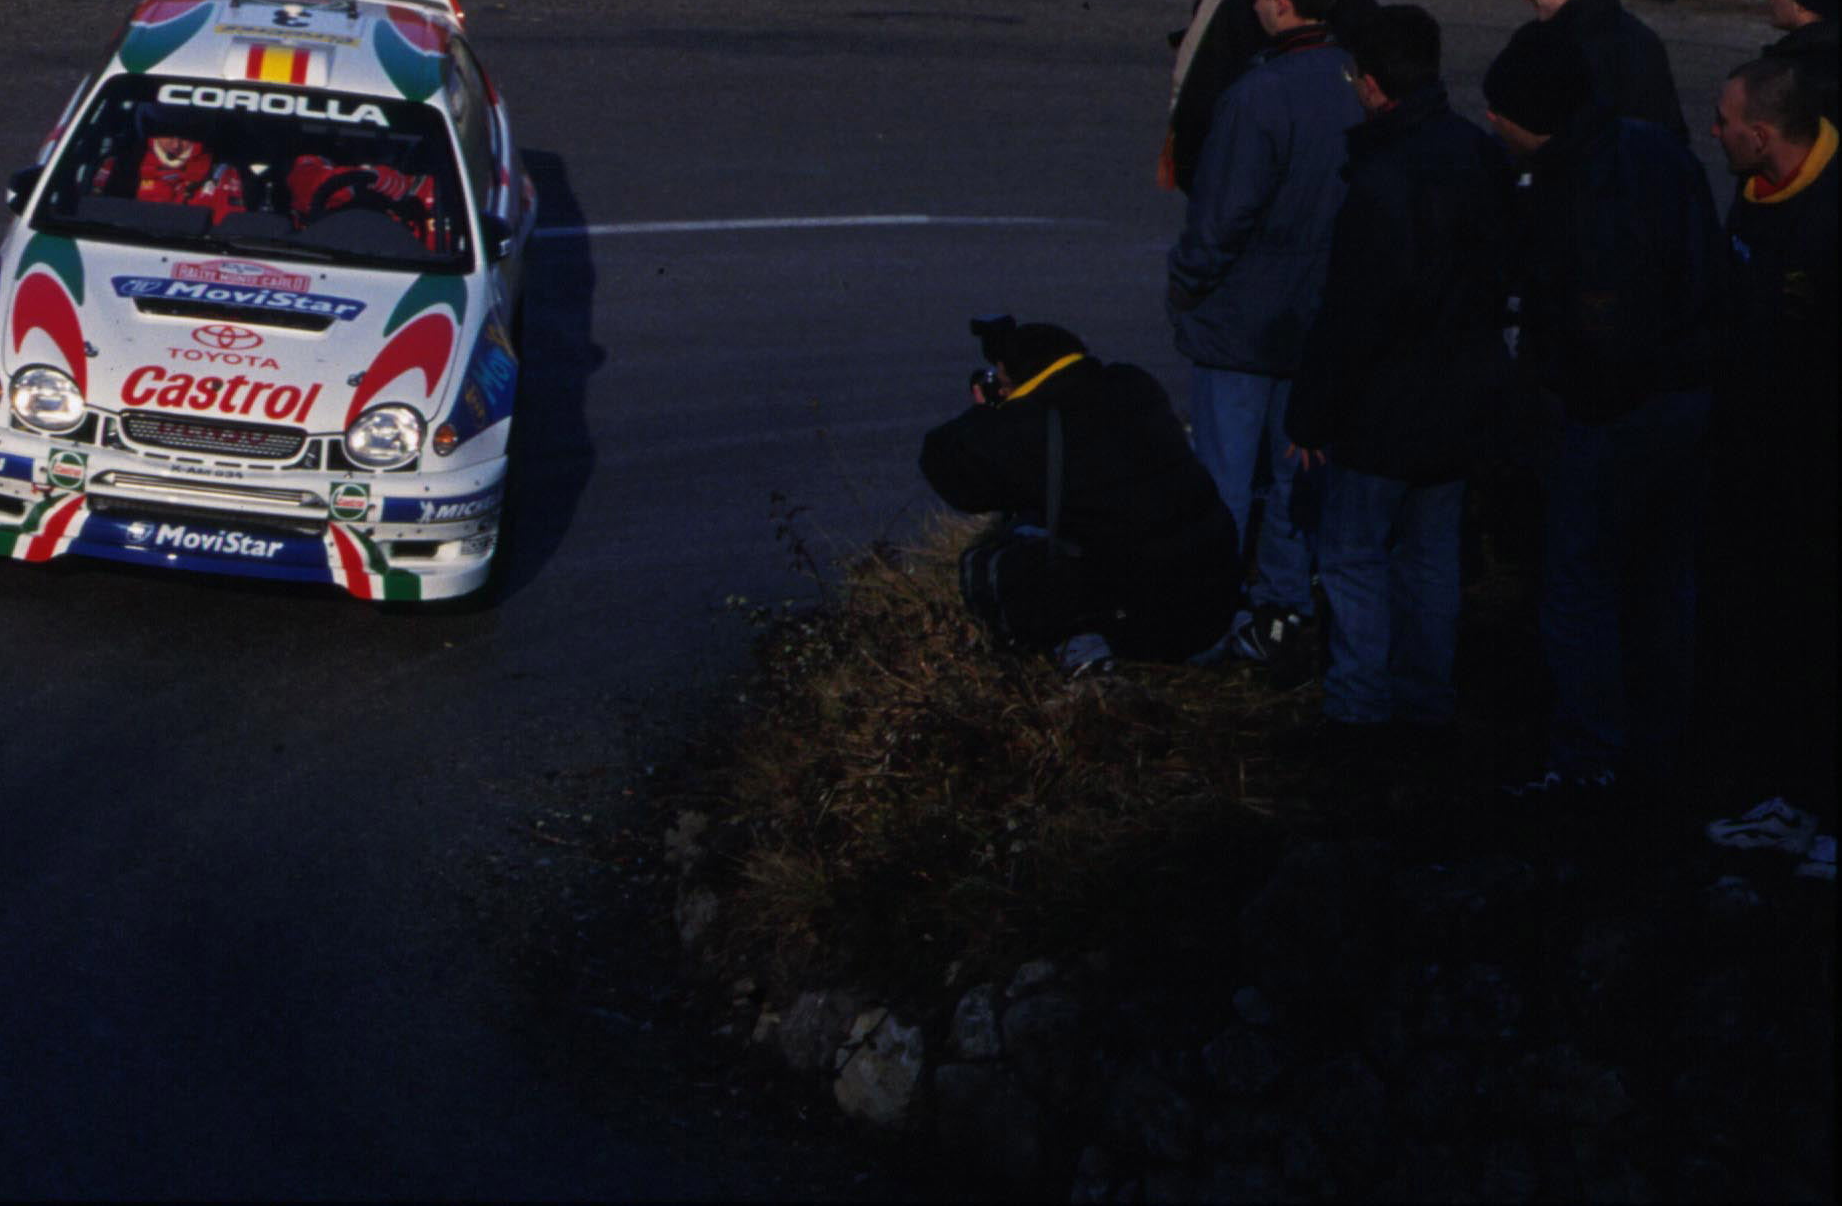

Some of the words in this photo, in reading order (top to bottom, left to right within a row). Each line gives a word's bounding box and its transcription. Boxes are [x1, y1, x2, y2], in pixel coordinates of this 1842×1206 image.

[157, 84, 390, 127] COROLLA
[164, 281, 357, 315] MoviStar
[166, 348, 281, 370] TOYOTA
[121, 365, 324, 423] Castrol
[154, 523, 284, 558] MoviStar
